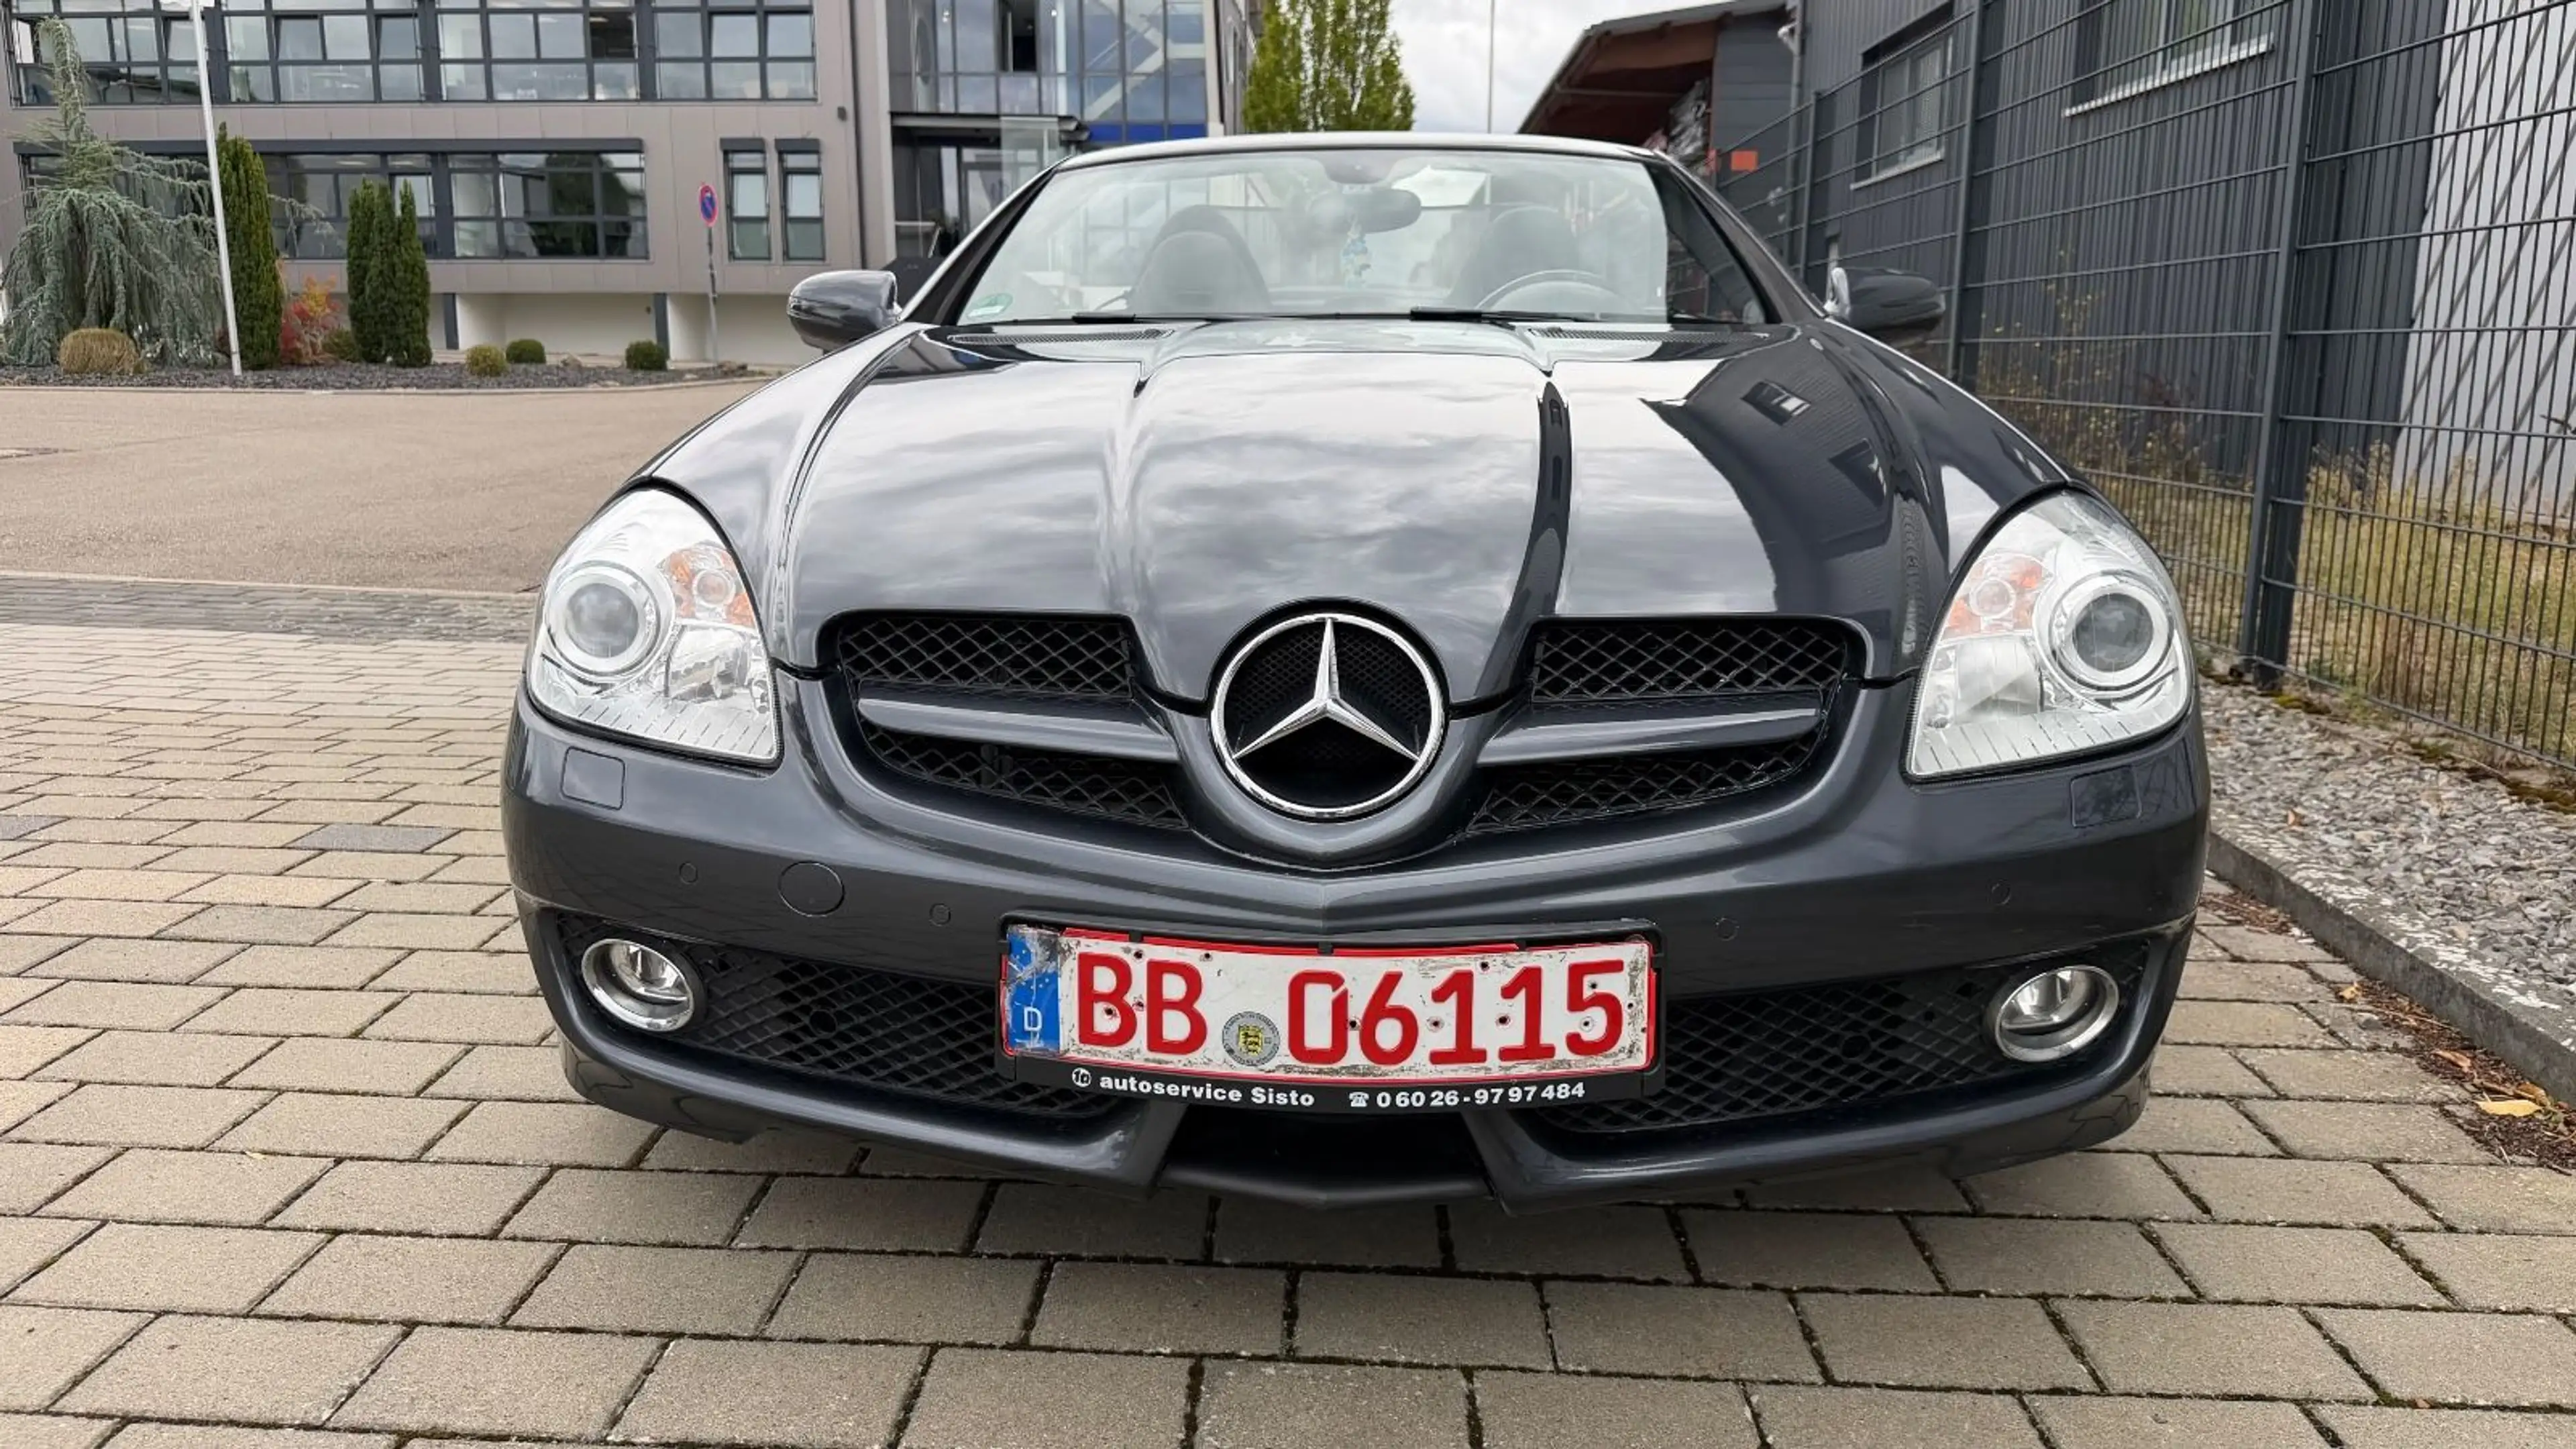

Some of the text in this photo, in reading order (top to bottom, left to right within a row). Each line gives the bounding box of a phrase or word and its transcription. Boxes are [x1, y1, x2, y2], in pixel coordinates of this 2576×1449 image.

[1024, 1006, 1042, 1032] D
[1077, 951, 1208, 1056] BB
[1287, 959, 1625, 1067] 06115
[1099, 1076, 1242, 1102] autoservice
[1251, 1087, 1316, 1106] Sisto
